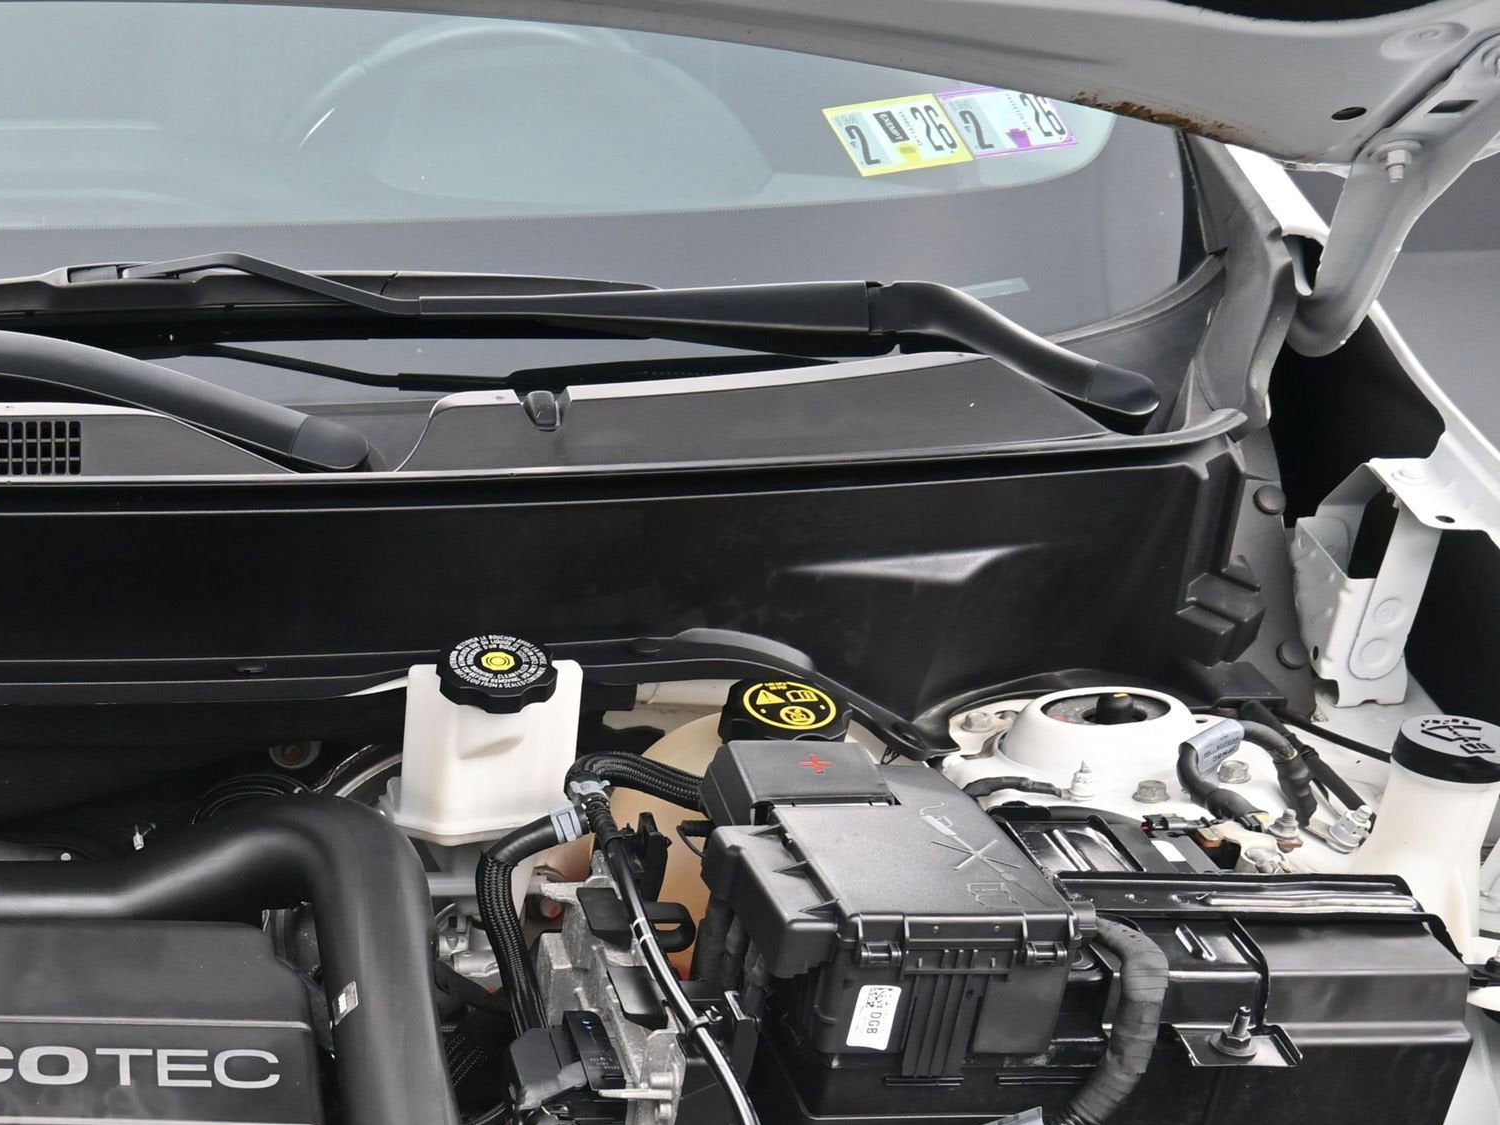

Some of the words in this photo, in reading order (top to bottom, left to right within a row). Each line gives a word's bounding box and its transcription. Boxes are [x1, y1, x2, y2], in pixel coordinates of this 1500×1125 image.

[878, 113, 904, 140] EXEMPT
[910, 105, 958, 151] 26
[959, 110, 994, 149] 2
[1019, 94, 1066, 137] 26
[844, 125, 881, 165] 2
[866, 1012, 882, 1034] DGB
